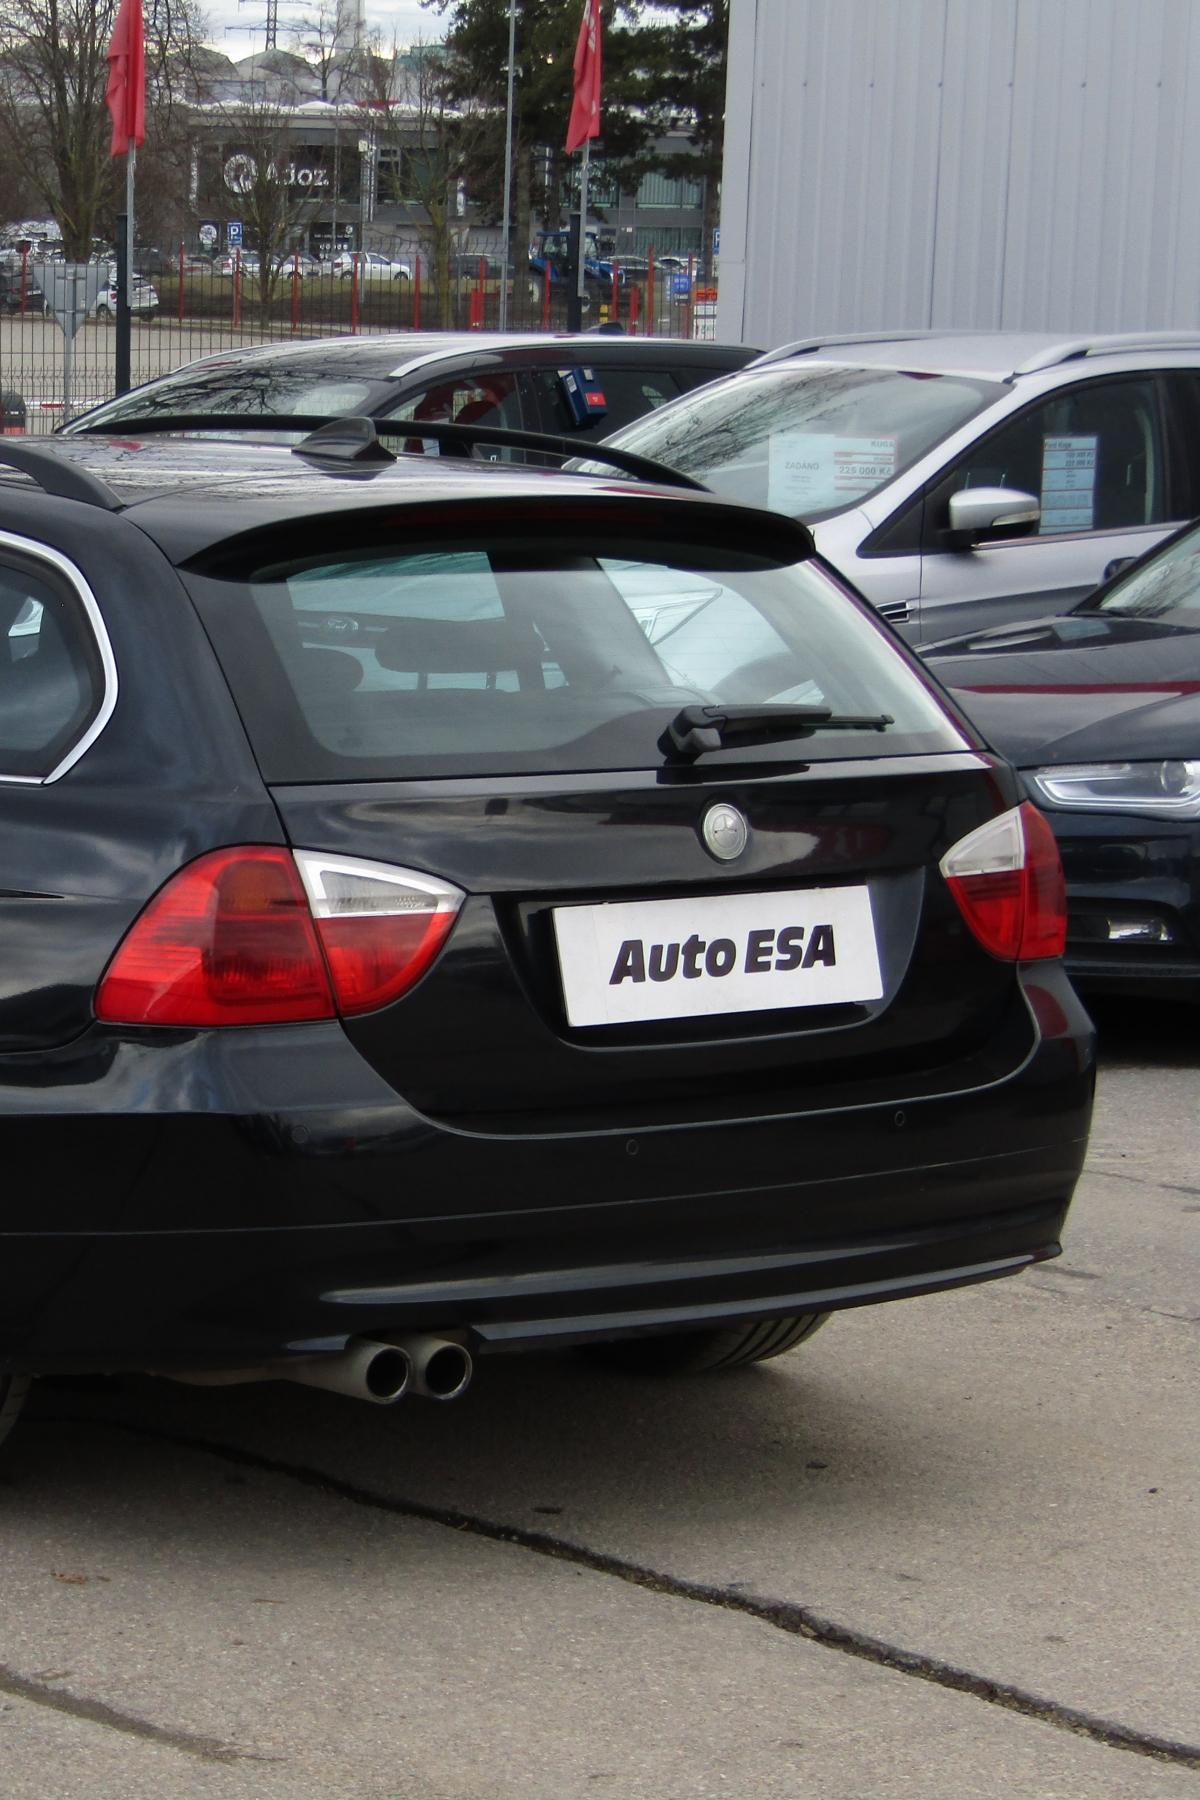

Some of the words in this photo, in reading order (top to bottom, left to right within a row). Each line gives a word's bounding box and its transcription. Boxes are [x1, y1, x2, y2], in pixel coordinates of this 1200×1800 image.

[230, 225, 239, 240] P
[859, 466, 877, 476] 000
[608, 934, 737, 985] Auto
[744, 924, 836, 974] ESA
